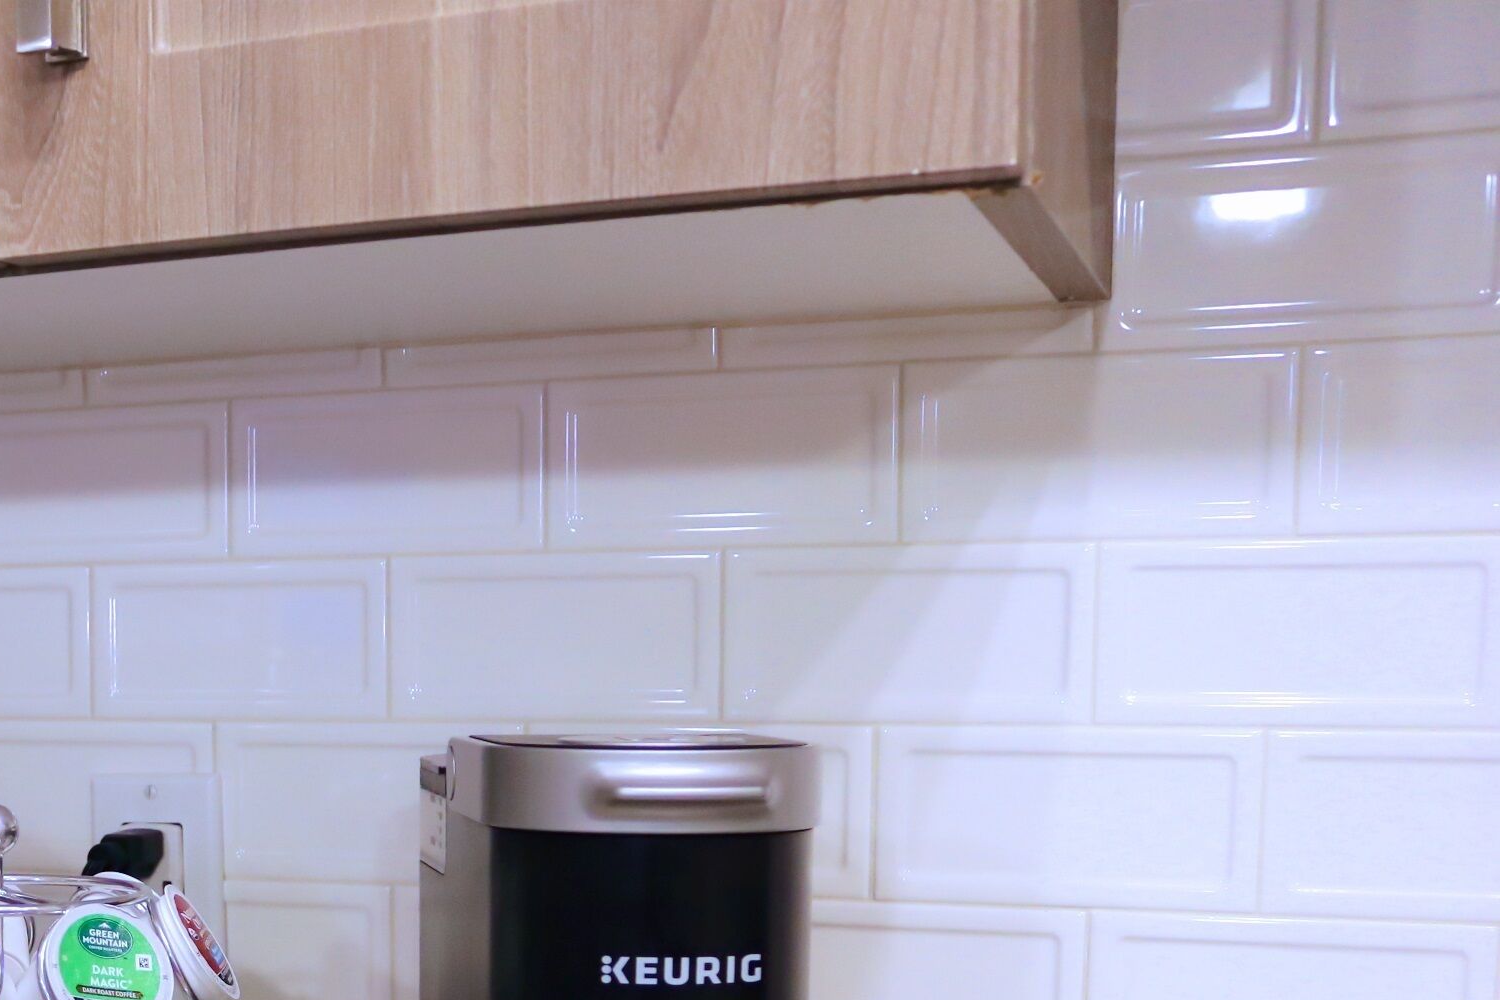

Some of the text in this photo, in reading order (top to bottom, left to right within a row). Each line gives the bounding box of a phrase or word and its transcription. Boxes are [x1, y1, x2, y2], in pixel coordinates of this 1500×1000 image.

[89, 929, 120, 938] GREEN
[82, 936, 128, 948] MOUNTAIN
[92, 964, 124, 977] DARK
[601, 953, 762, 986] KEURIG
